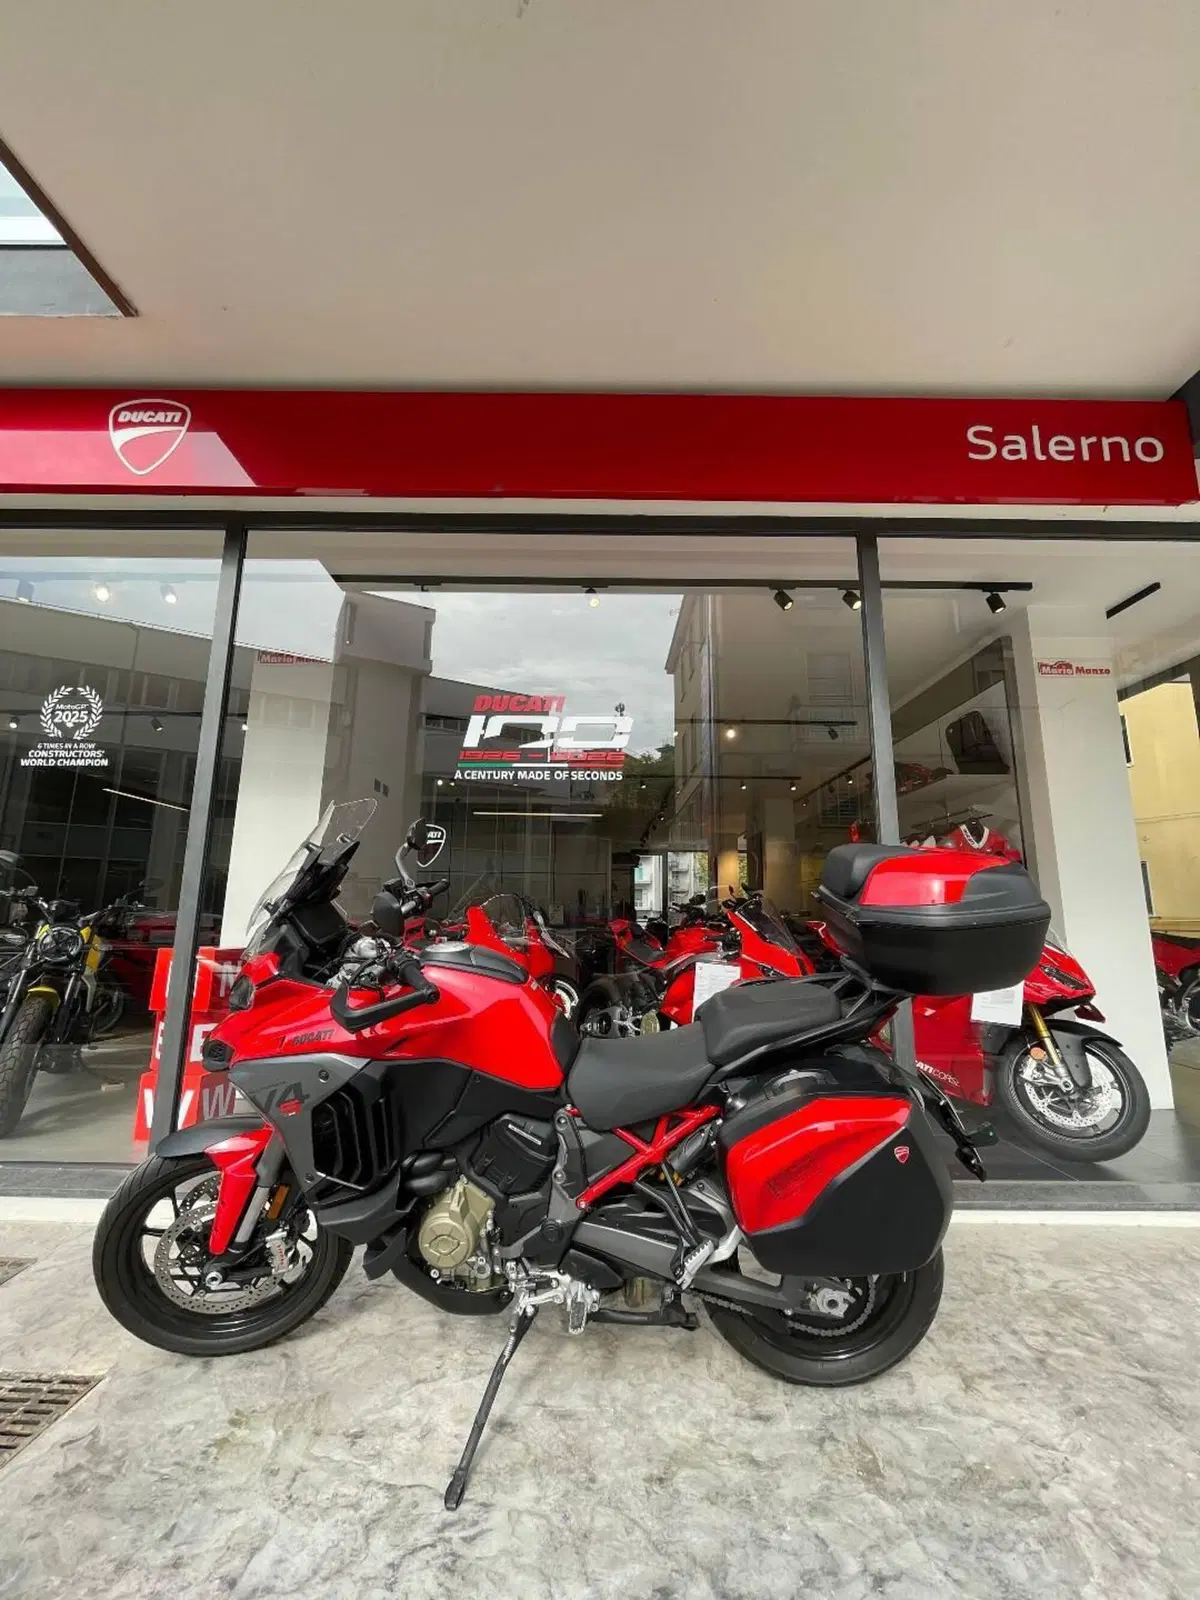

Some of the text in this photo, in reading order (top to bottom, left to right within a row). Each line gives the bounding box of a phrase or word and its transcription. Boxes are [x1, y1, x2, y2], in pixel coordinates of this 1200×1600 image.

[118, 411, 183, 422] DUCATI
[966, 425, 1164, 463] Salerno
[1076, 666, 1111, 675] Manzo
[473, 695, 566, 712] DUCATI
[54, 711, 88, 723] 2025
[463, 715, 634, 748] 100
[459, 751, 521, 761] 1926
[20, 758, 109, 767] WORLD CHAMPION
[454, 770, 623, 781] A CENTURY MADE OF SECONDS
